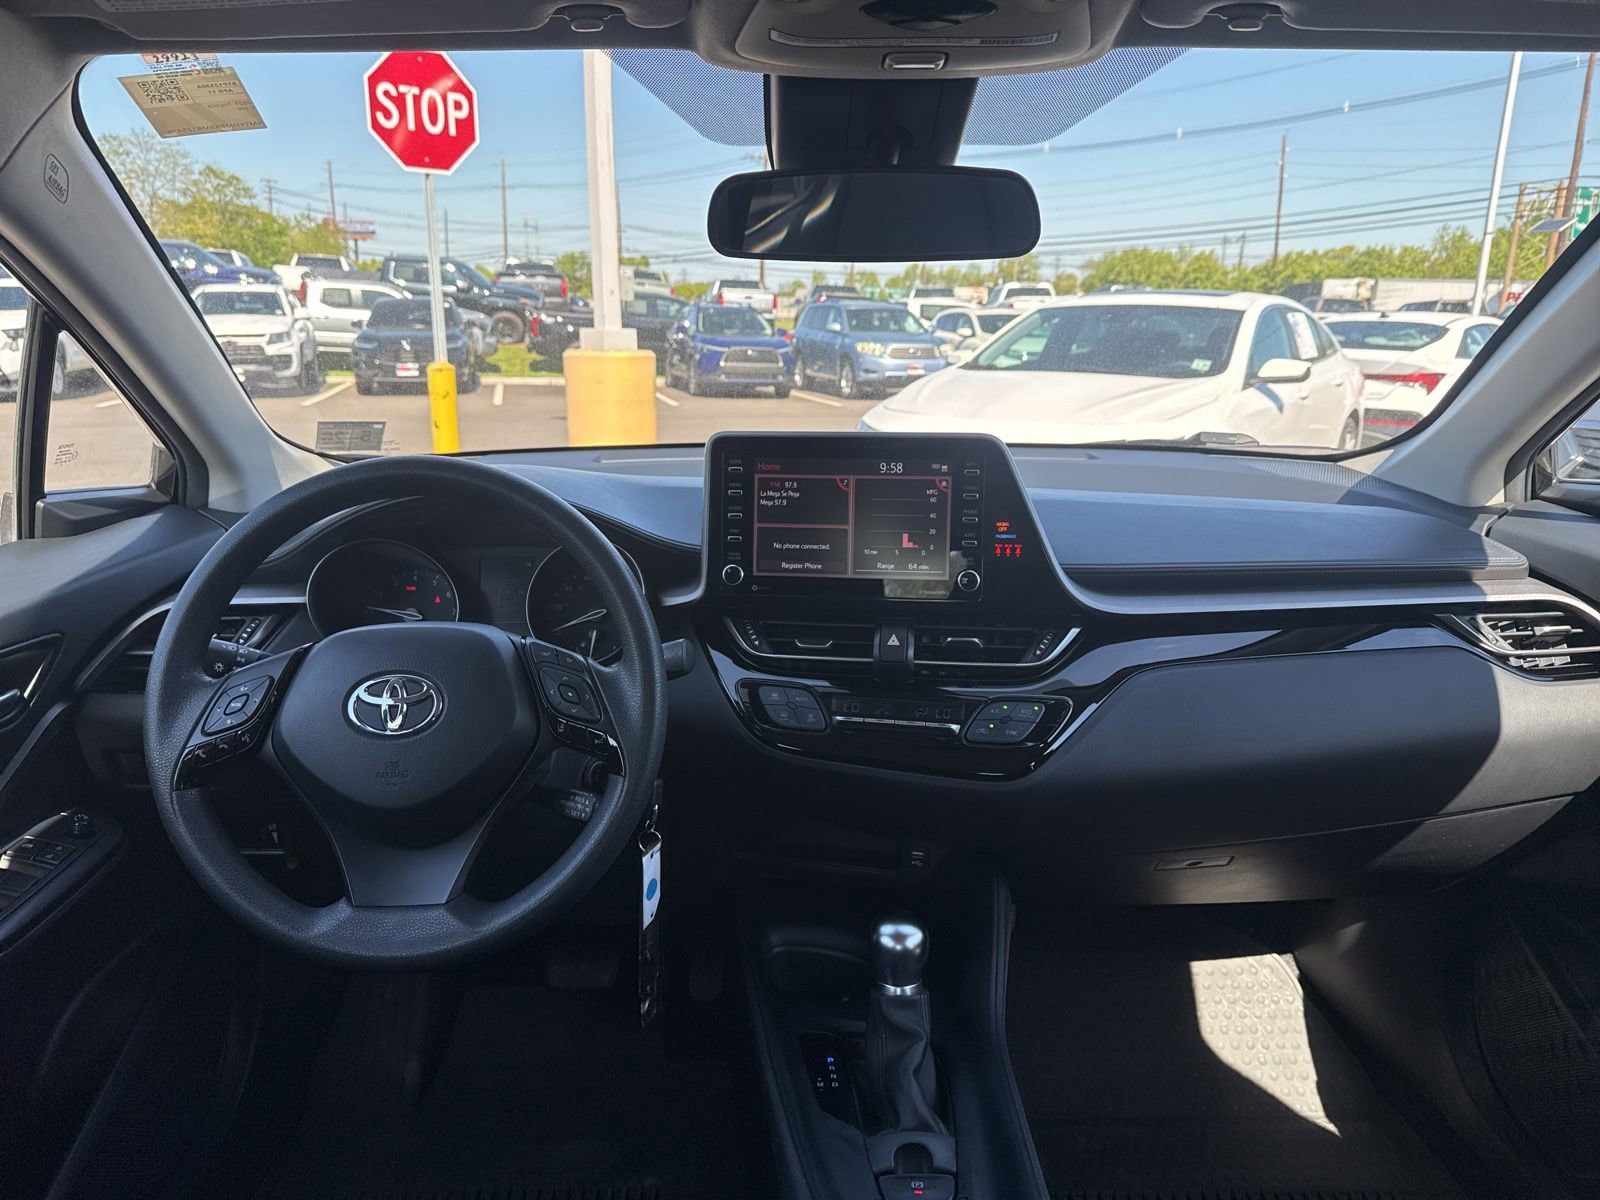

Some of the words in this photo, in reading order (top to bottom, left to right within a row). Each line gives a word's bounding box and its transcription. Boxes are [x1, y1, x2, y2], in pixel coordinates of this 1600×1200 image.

[375, 81, 470, 137] STOP
[757, 463, 781, 471] Home
[879, 462, 904, 474] 9:58
[767, 490, 781, 498] Mega
[788, 490, 800, 499] Pega
[926, 488, 938, 496] MPG
[760, 499, 774, 507] Mega
[783, 542, 800, 551] phone
[800, 542, 831, 550] connected.
[781, 562, 804, 571] Register
[804, 562, 822, 570] Phone
[877, 562, 895, 571] Range
[908, 562, 917, 570] 64
[825, 1055, 835, 1064] P
